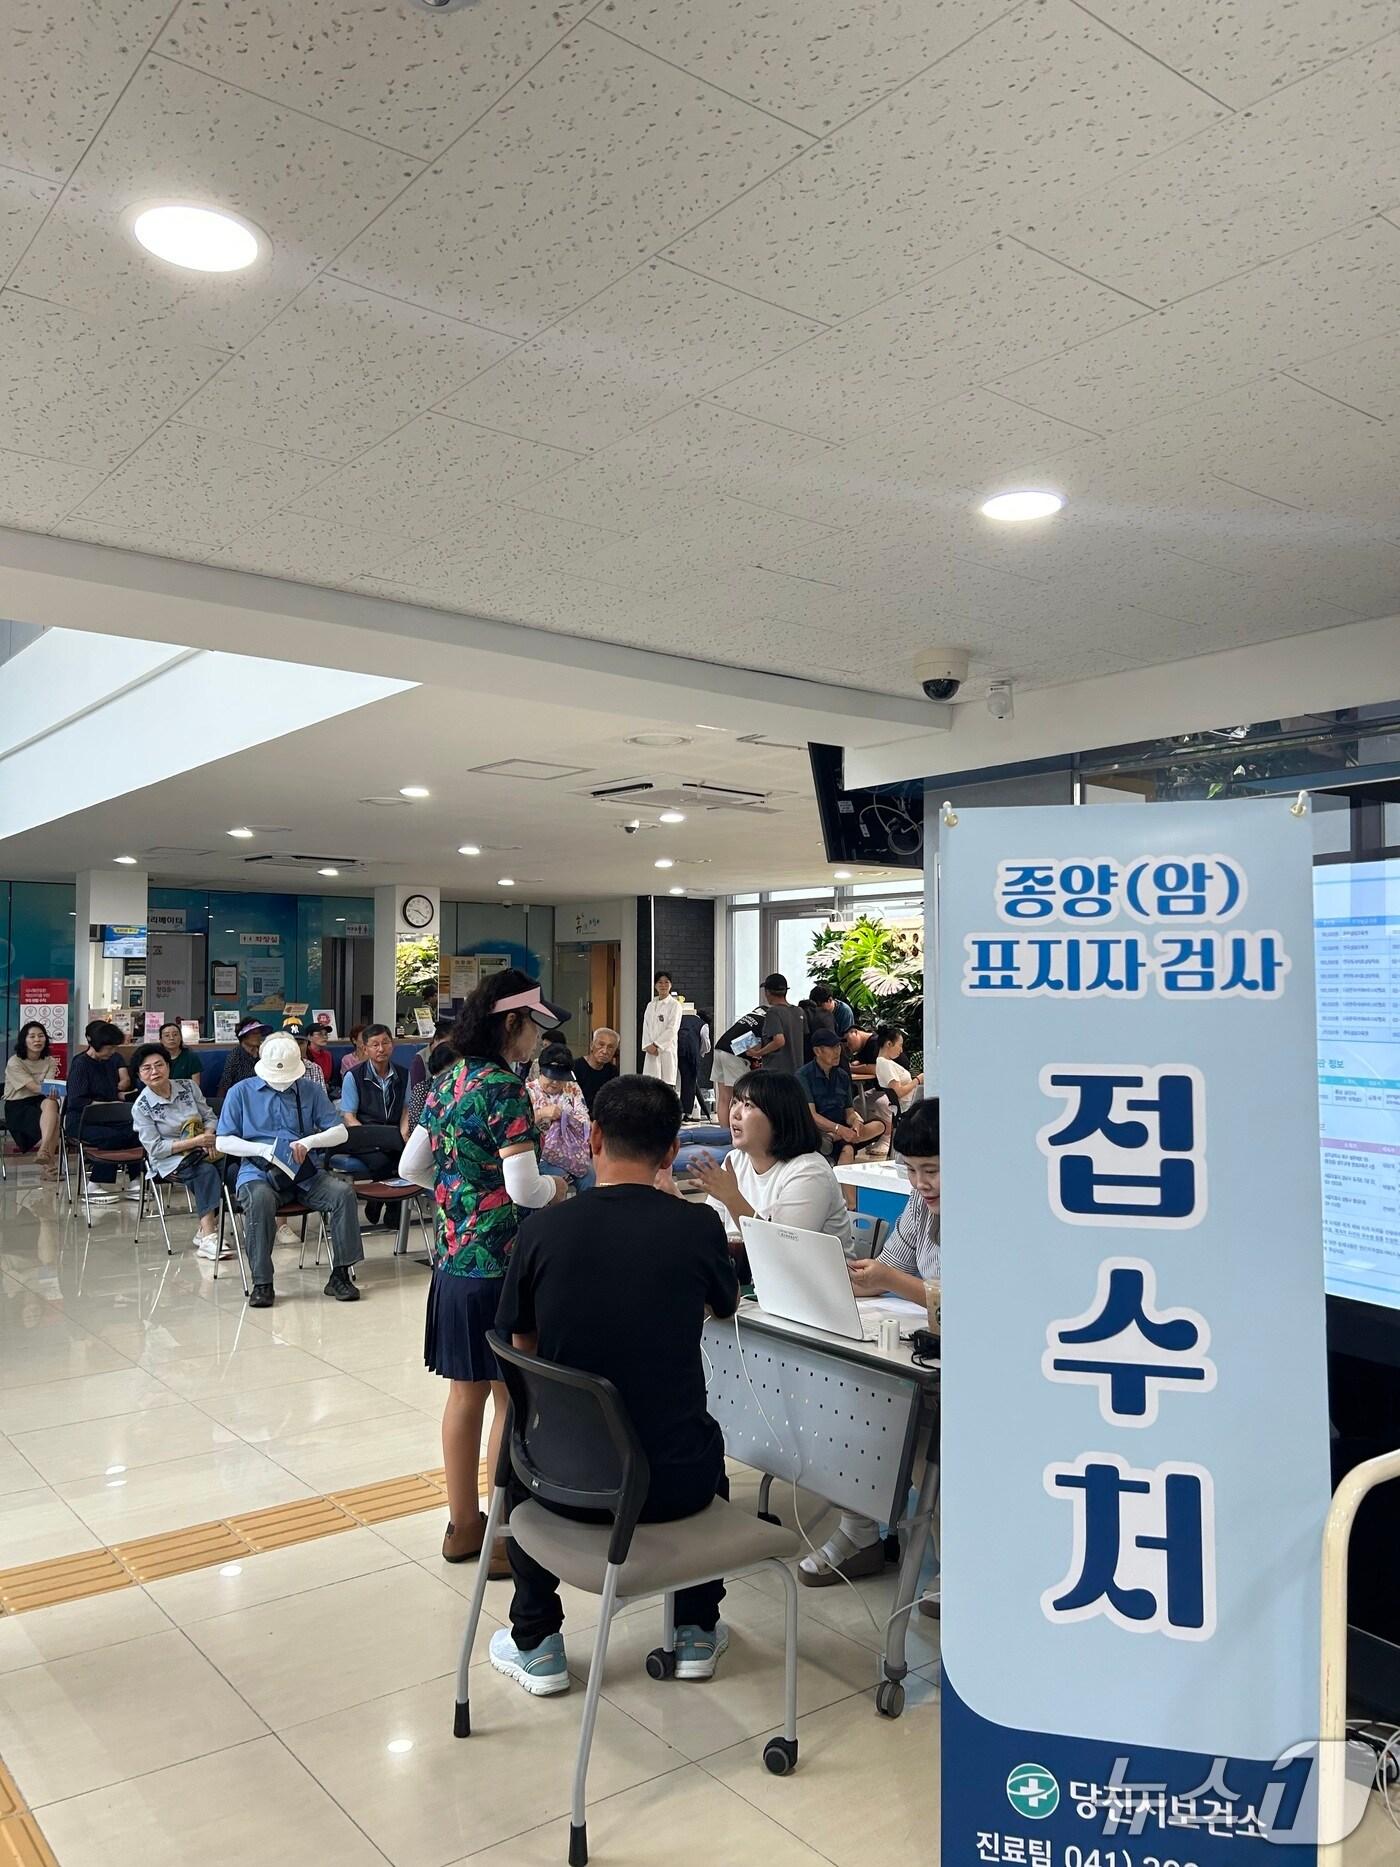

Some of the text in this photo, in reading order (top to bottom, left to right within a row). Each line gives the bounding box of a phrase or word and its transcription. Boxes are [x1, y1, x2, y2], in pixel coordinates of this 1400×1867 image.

[1000, 860, 1241, 919] 종양(암)
[967, 936, 1284, 993] 표지자 검사
[1047, 1073, 1206, 1629] 접수처
[1069, 1780, 1269, 1839] 당진시보건소
[975, 1832, 1052, 1867] 진료팀
